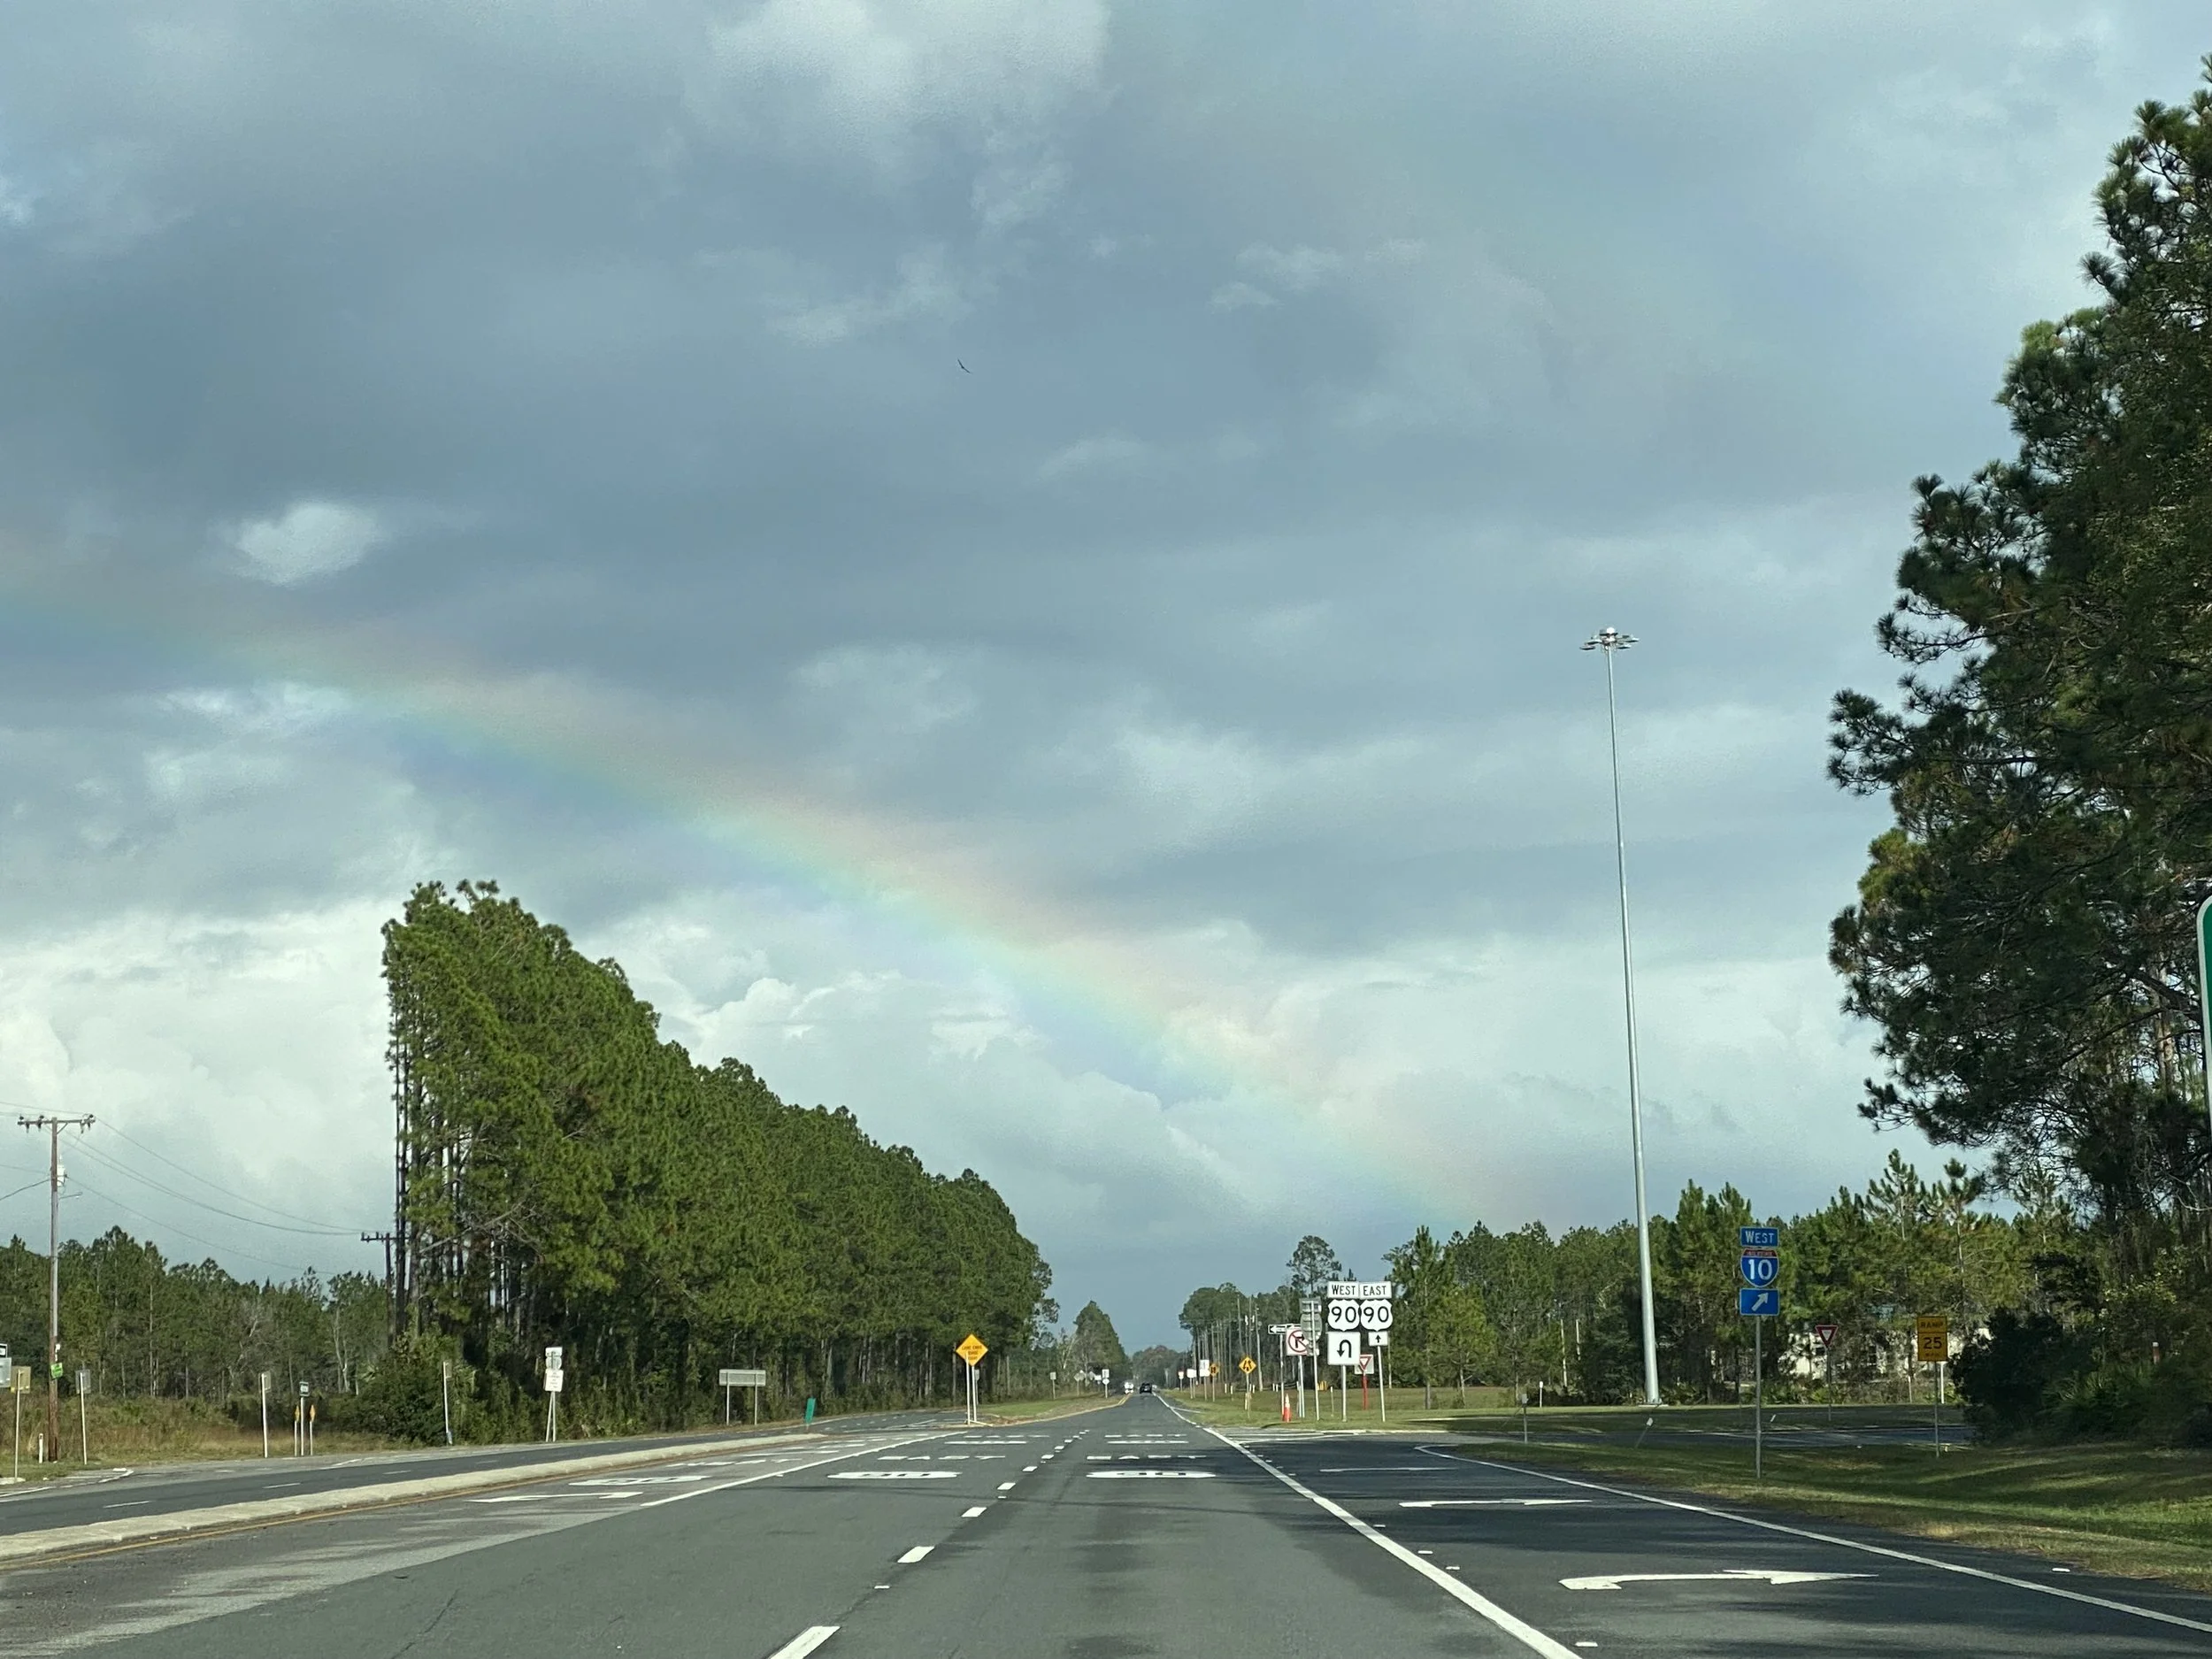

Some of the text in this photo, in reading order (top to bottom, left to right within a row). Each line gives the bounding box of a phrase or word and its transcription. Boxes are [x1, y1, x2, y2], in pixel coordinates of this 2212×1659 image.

[1745, 1231, 1774, 1244] WEST
[1748, 1259, 1772, 1280] 10
[1332, 1285, 1356, 1295] WEST
[1363, 1286, 1386, 1296] EAST
[1332, 1306, 1356, 1323] 90
[1363, 1306, 1389, 1323] 90
[1924, 1336, 1942, 1349] 25
